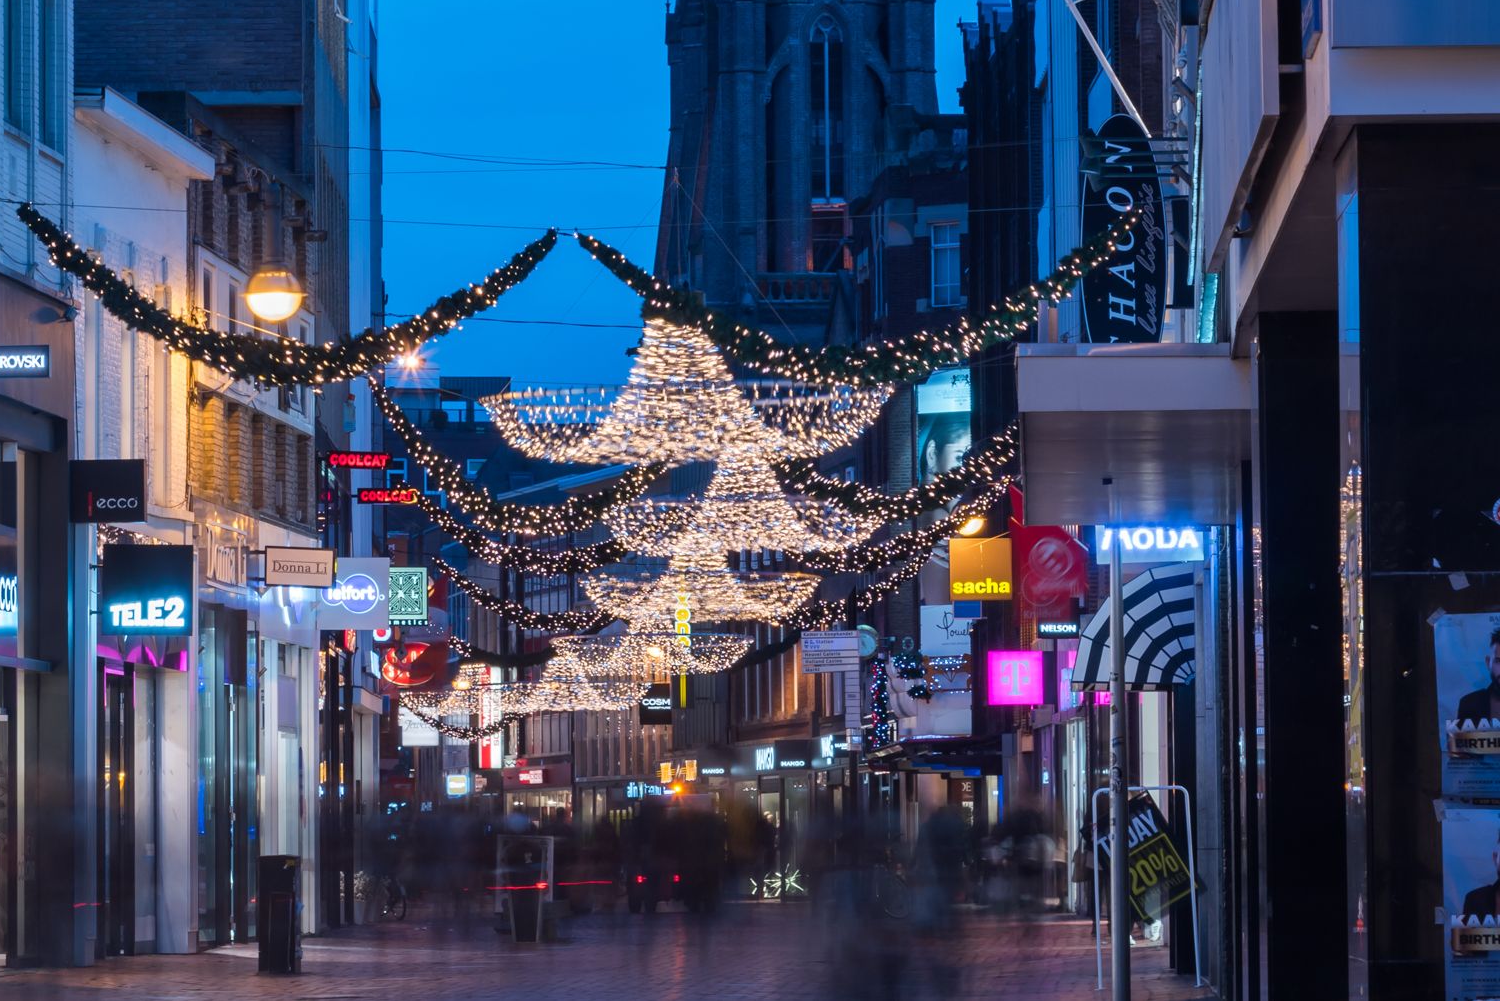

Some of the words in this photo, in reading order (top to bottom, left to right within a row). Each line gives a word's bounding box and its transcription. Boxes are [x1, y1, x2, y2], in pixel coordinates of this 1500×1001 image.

[1136, 181, 1164, 275] lingerie
[329, 453, 389, 467] COOLCAT
[360, 490, 412, 502] COOLCAT
[96, 498, 138, 509] ecco
[271, 560, 311, 574] Donna
[315, 562, 328, 575] Li
[952, 577, 1011, 595] sacha
[109, 596, 185, 627] TELE2
[1040, 624, 1077, 633] NELSON
[1455, 738, 1500, 749] BIRTH
[1451, 914, 1500, 928] KAA
